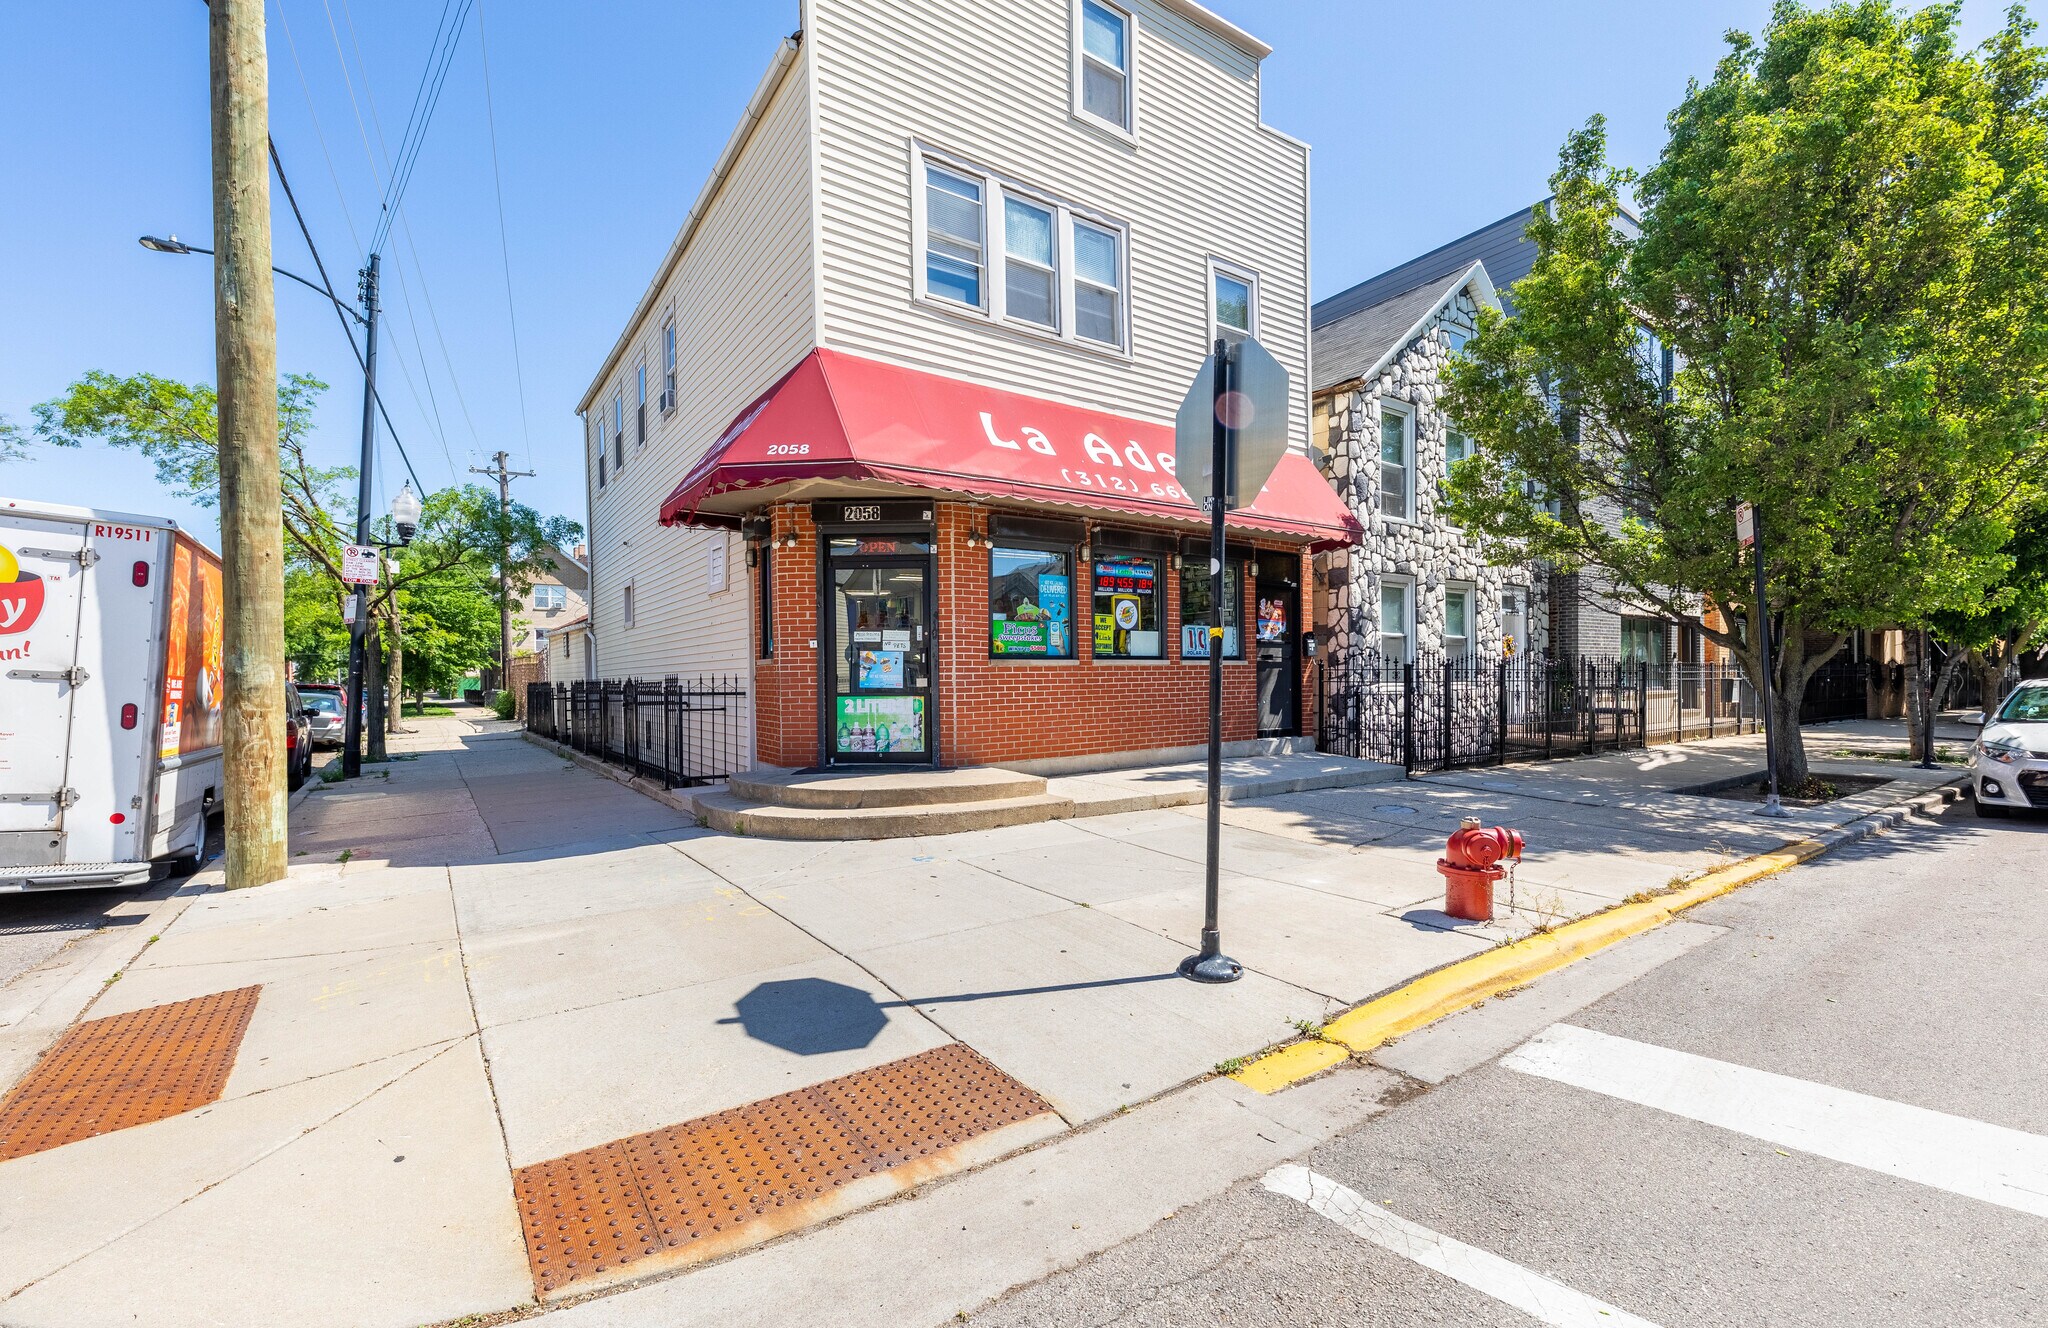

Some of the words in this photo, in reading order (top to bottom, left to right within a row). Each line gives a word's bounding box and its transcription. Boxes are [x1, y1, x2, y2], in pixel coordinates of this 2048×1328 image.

[766, 444, 810, 455] 2058
[979, 411, 1057, 456] La
[1083, 432, 1176, 476] Ade
[1061, 469, 1139, 493] (312)
[845, 506, 880, 521] 2058
[95, 524, 151, 542] R19511
[860, 541, 896, 553] OPEN
[1099, 576, 1115, 587] 189
[1116, 577, 1133, 588] 455
[1137, 579, 1153, 589] 184
[1003, 622, 1038, 635] Ficus
[998, 633, 1042, 643] Sweepstakes
[844, 699, 854, 713] 2
